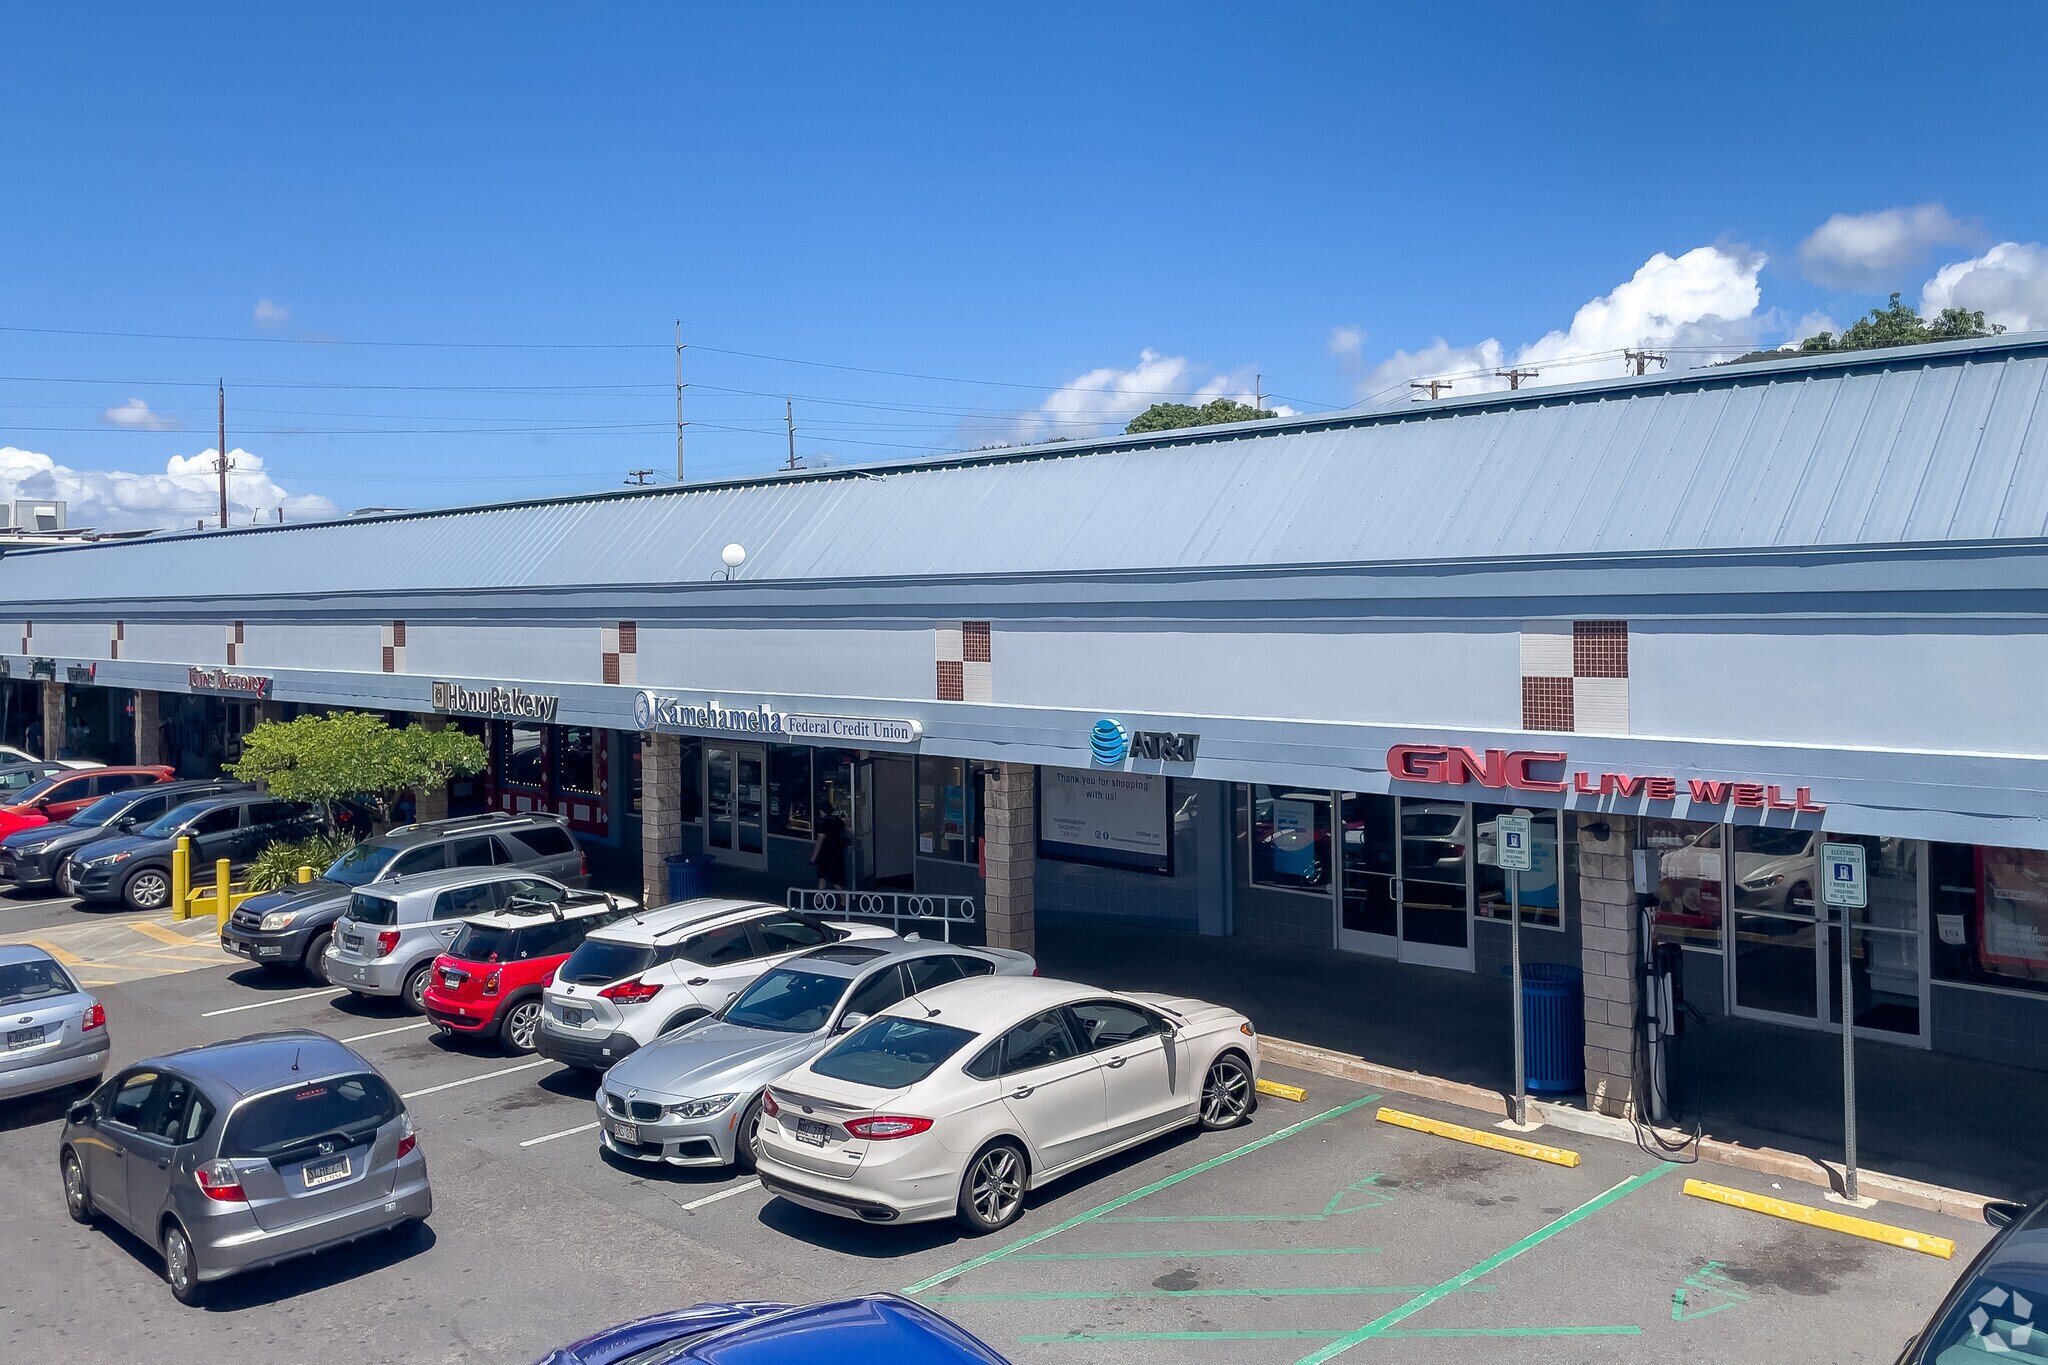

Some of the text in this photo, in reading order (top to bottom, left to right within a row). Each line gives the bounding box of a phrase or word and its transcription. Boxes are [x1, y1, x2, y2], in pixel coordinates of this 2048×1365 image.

[652, 697, 783, 733] Kamehameha
[788, 717, 910, 740] Federal Credit Union
[1129, 731, 1200, 762] AT&T
[1056, 772, 1149, 792] Thank you for shopping
[1386, 743, 1828, 812] GNC LIVE WELL
[1085, 790, 1118, 801] with us!
[1060, 831, 1079, 839] CENTER
